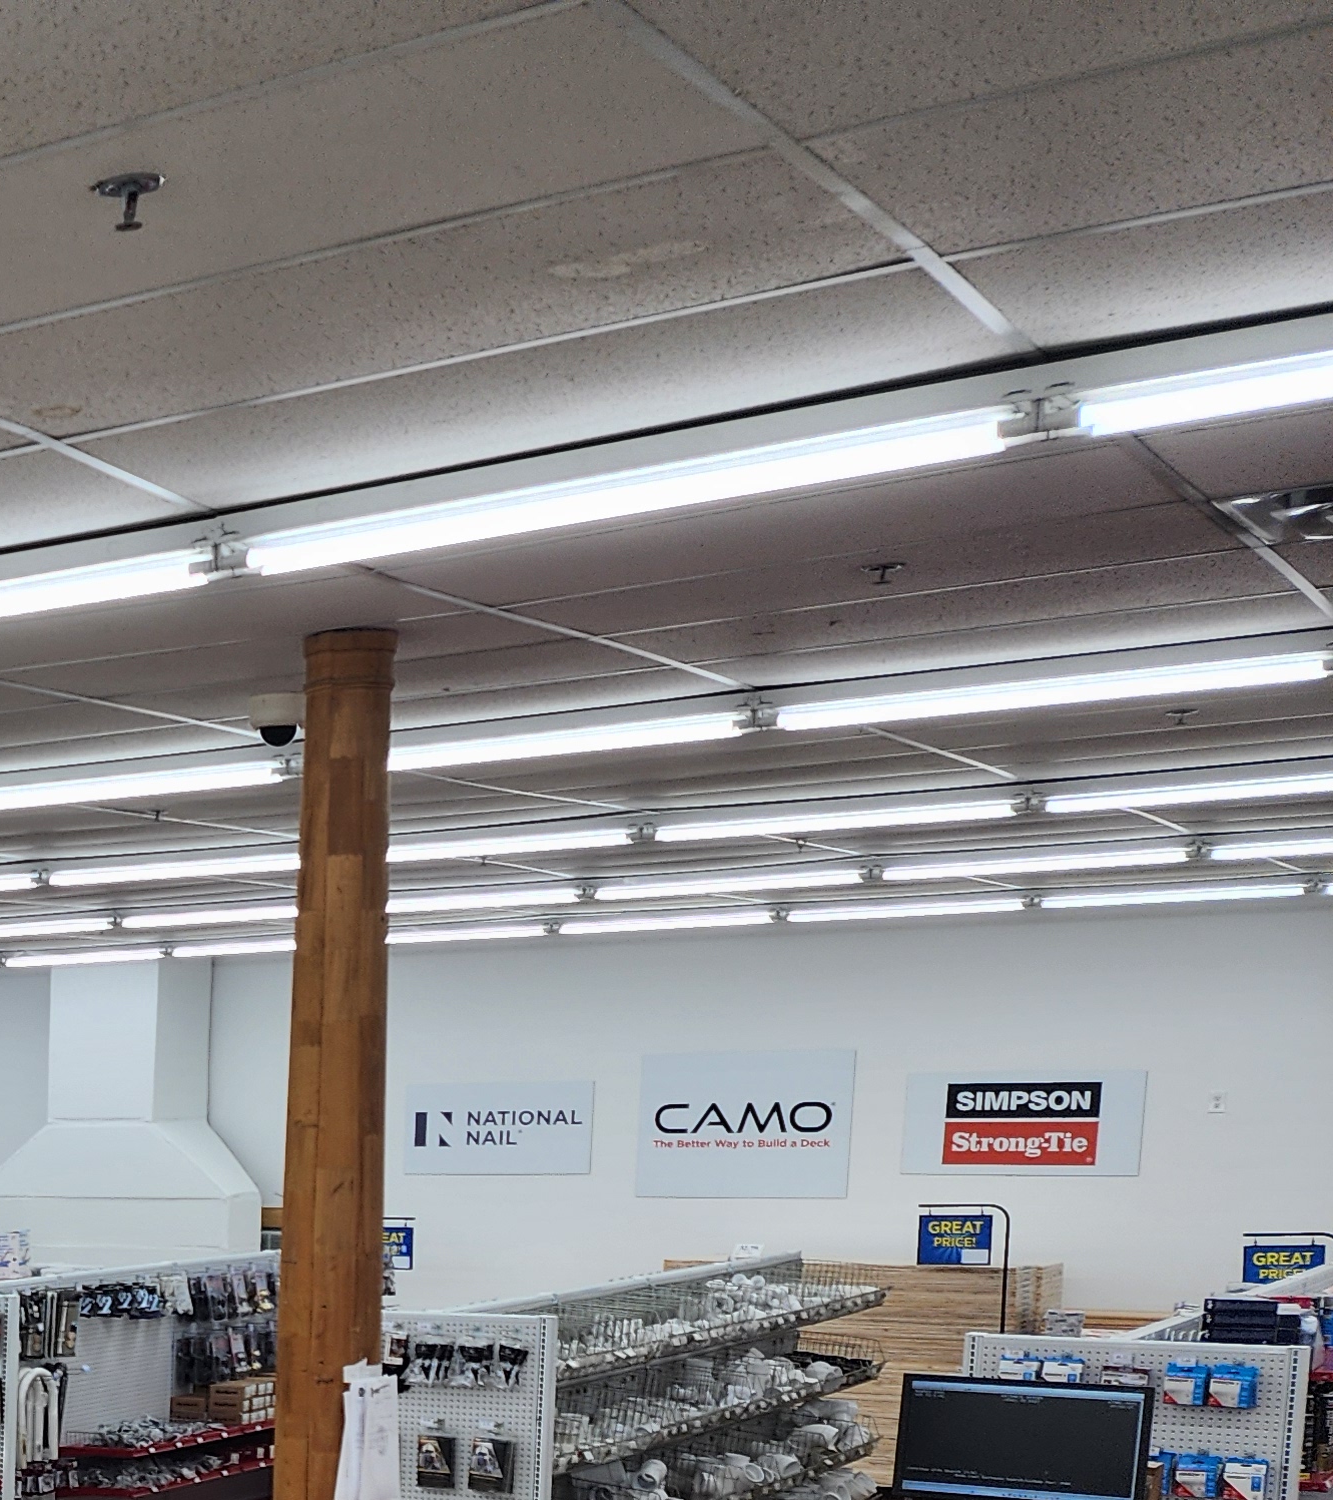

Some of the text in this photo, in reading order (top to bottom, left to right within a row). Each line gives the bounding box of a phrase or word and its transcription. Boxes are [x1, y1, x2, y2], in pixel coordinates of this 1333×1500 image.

[955, 1090, 1092, 1111] SIMPSON
[467, 1110, 582, 1127] NATIONAL
[654, 1101, 833, 1134] CAMO
[466, 1130, 517, 1146] NAIL
[653, 1138, 830, 1151] The Better Way to Build a Deck
[951, 1132, 1088, 1157] Strong-Tie
[928, 1221, 983, 1234] GREAT
[383, 1232, 405, 1243] EAT
[934, 1237, 976, 1247] PRICE!
[1252, 1252, 1314, 1266] GREAT
